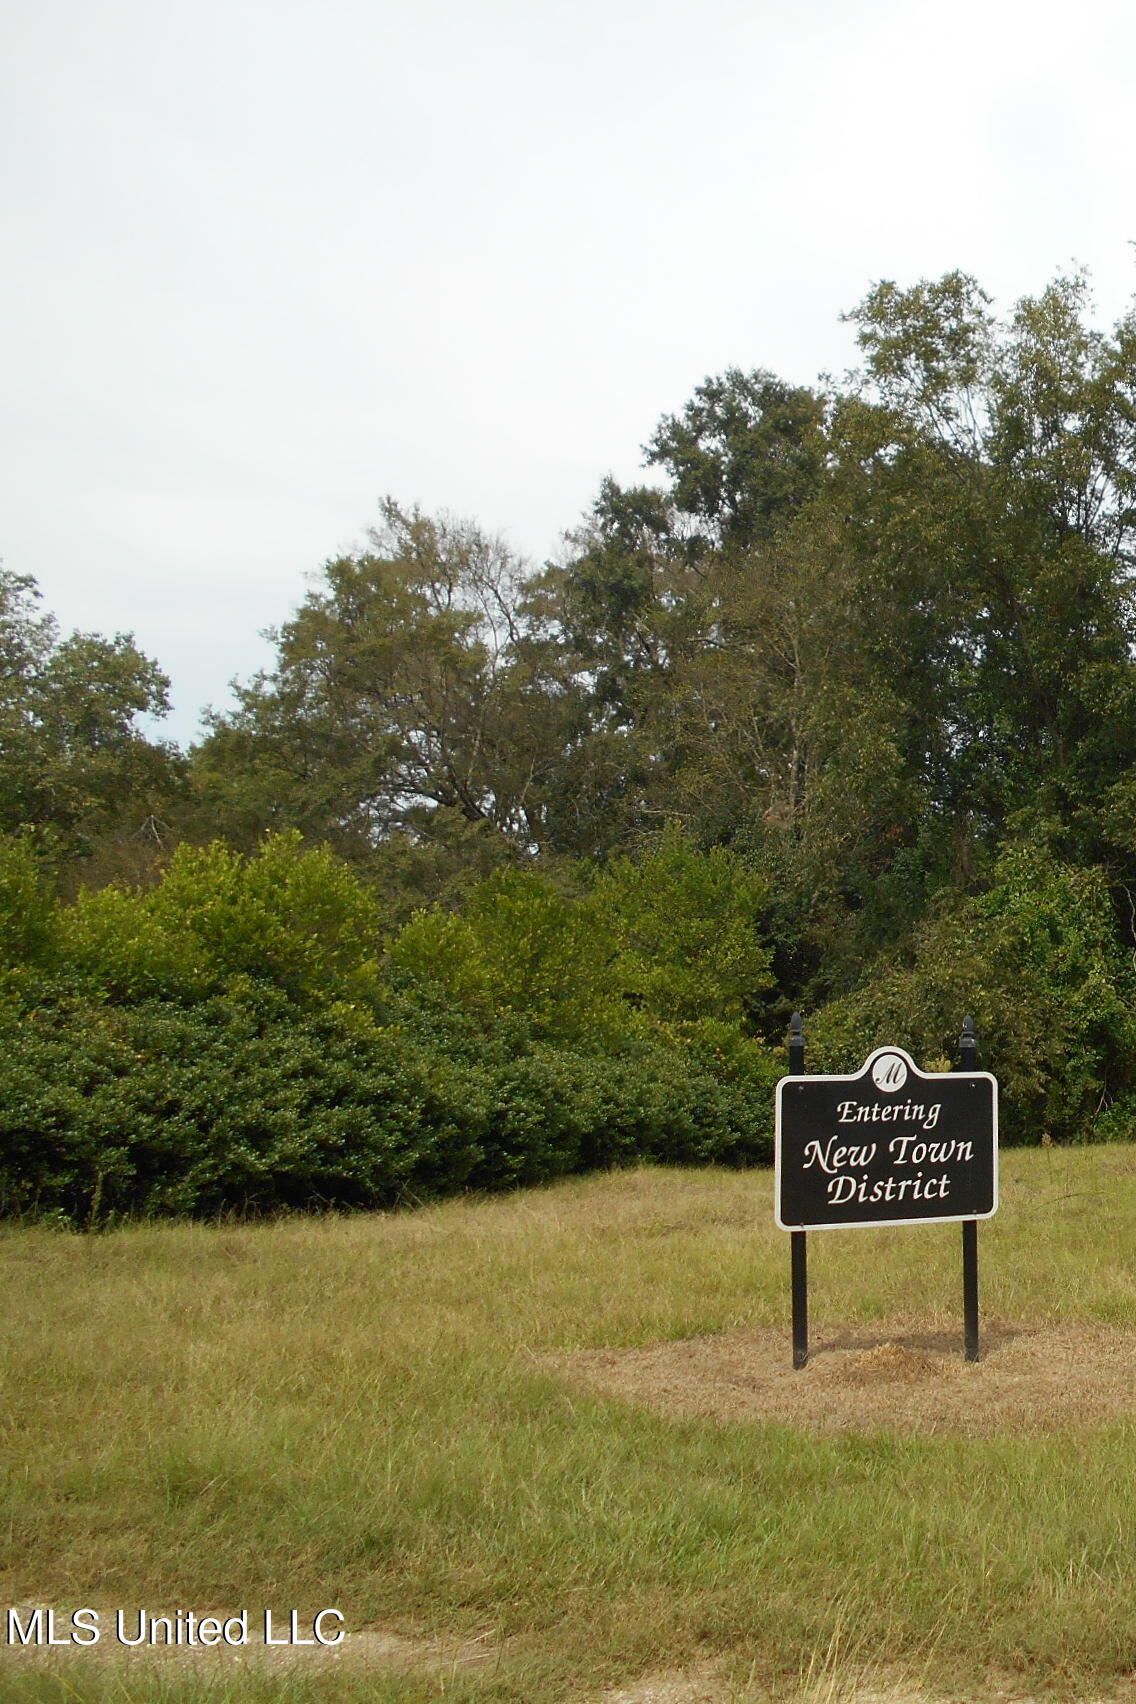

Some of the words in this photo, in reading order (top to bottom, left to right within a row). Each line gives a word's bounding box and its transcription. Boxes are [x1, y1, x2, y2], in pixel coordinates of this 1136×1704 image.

[875, 1062, 905, 1085] M
[836, 1099, 942, 1129] Entering
[802, 1135, 877, 1173] New
[889, 1134, 975, 1165] Town
[827, 1172, 951, 1205] District
